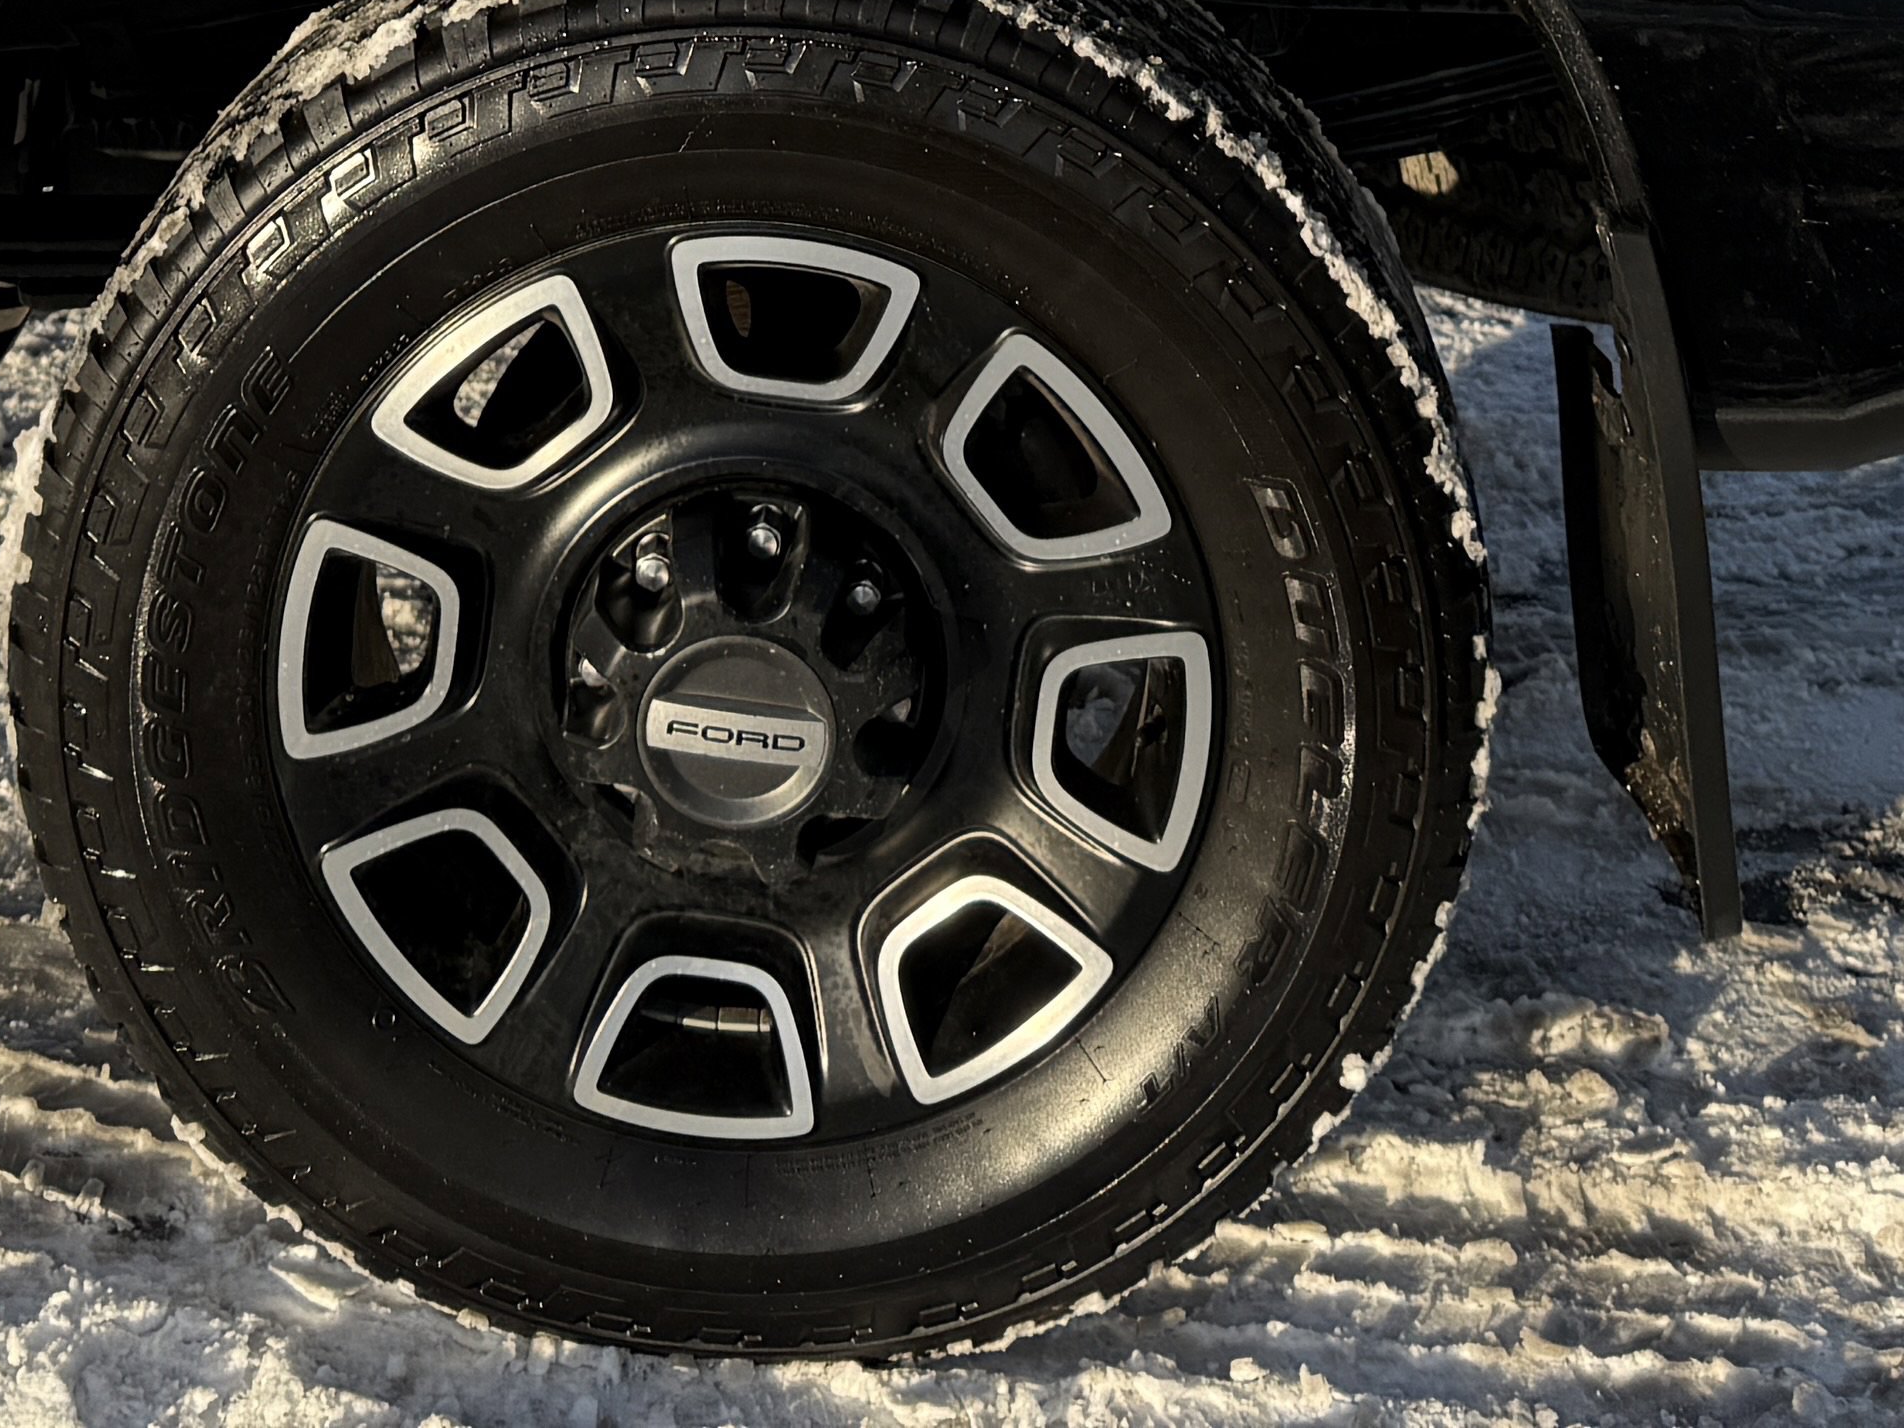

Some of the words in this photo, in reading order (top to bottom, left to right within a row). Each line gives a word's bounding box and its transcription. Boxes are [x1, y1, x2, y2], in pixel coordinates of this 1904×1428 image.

[144, 345, 296, 1013] BRIDGESTONE
[665, 719, 807, 753] FORD
[1233, 473, 1346, 987] DUELER
[1137, 994, 1221, 1114] A/T
